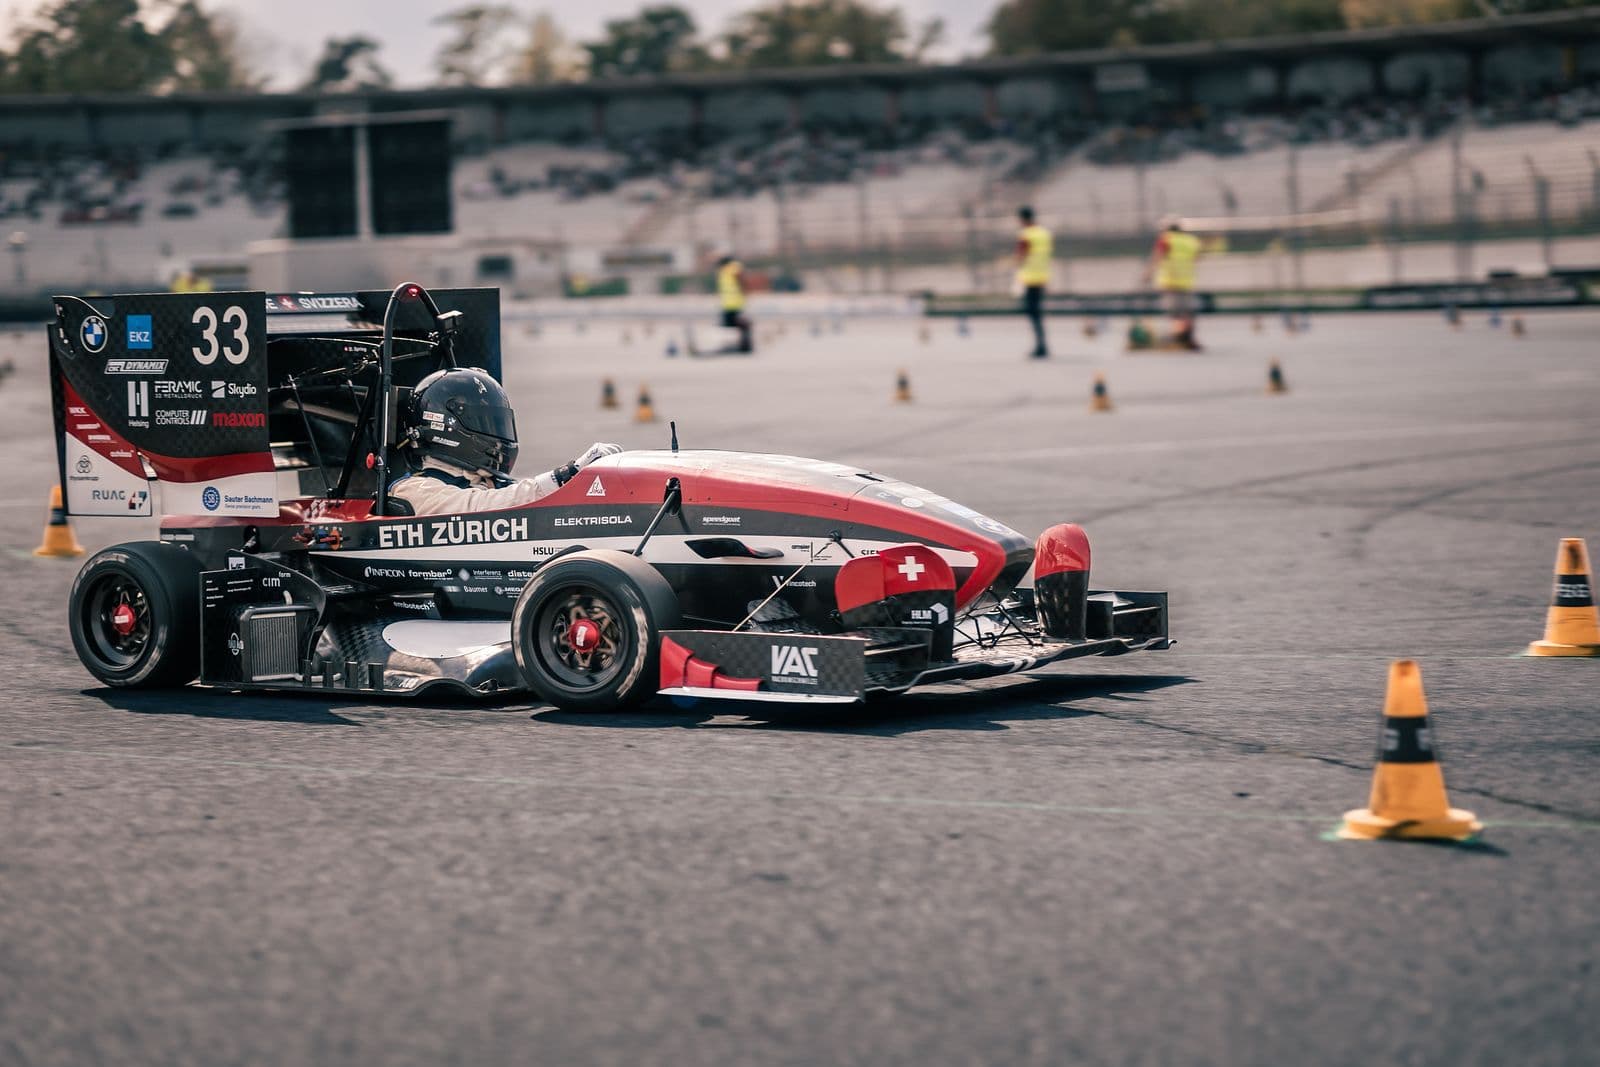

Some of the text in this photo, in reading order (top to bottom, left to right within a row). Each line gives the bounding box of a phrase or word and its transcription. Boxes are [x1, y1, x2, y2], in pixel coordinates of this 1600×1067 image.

[298, 297, 364, 309] SVIZZERA
[129, 331, 150, 342] EKZ
[192, 306, 250, 365] 33
[126, 361, 166, 370] DYNAMIX
[154, 380, 203, 393] FERAMIC
[228, 382, 257, 398] Skydio
[155, 410, 190, 418] COMPUTER
[212, 412, 266, 427] maxon
[128, 420, 150, 429] Helsing
[155, 417, 190, 425] CONTROLS
[554, 515, 633, 527] ELEKTRISOLA
[379, 516, 528, 548] ETH ZÜRICH
[532, 546, 554, 556] HSLU
[372, 568, 406, 578] INFICON
